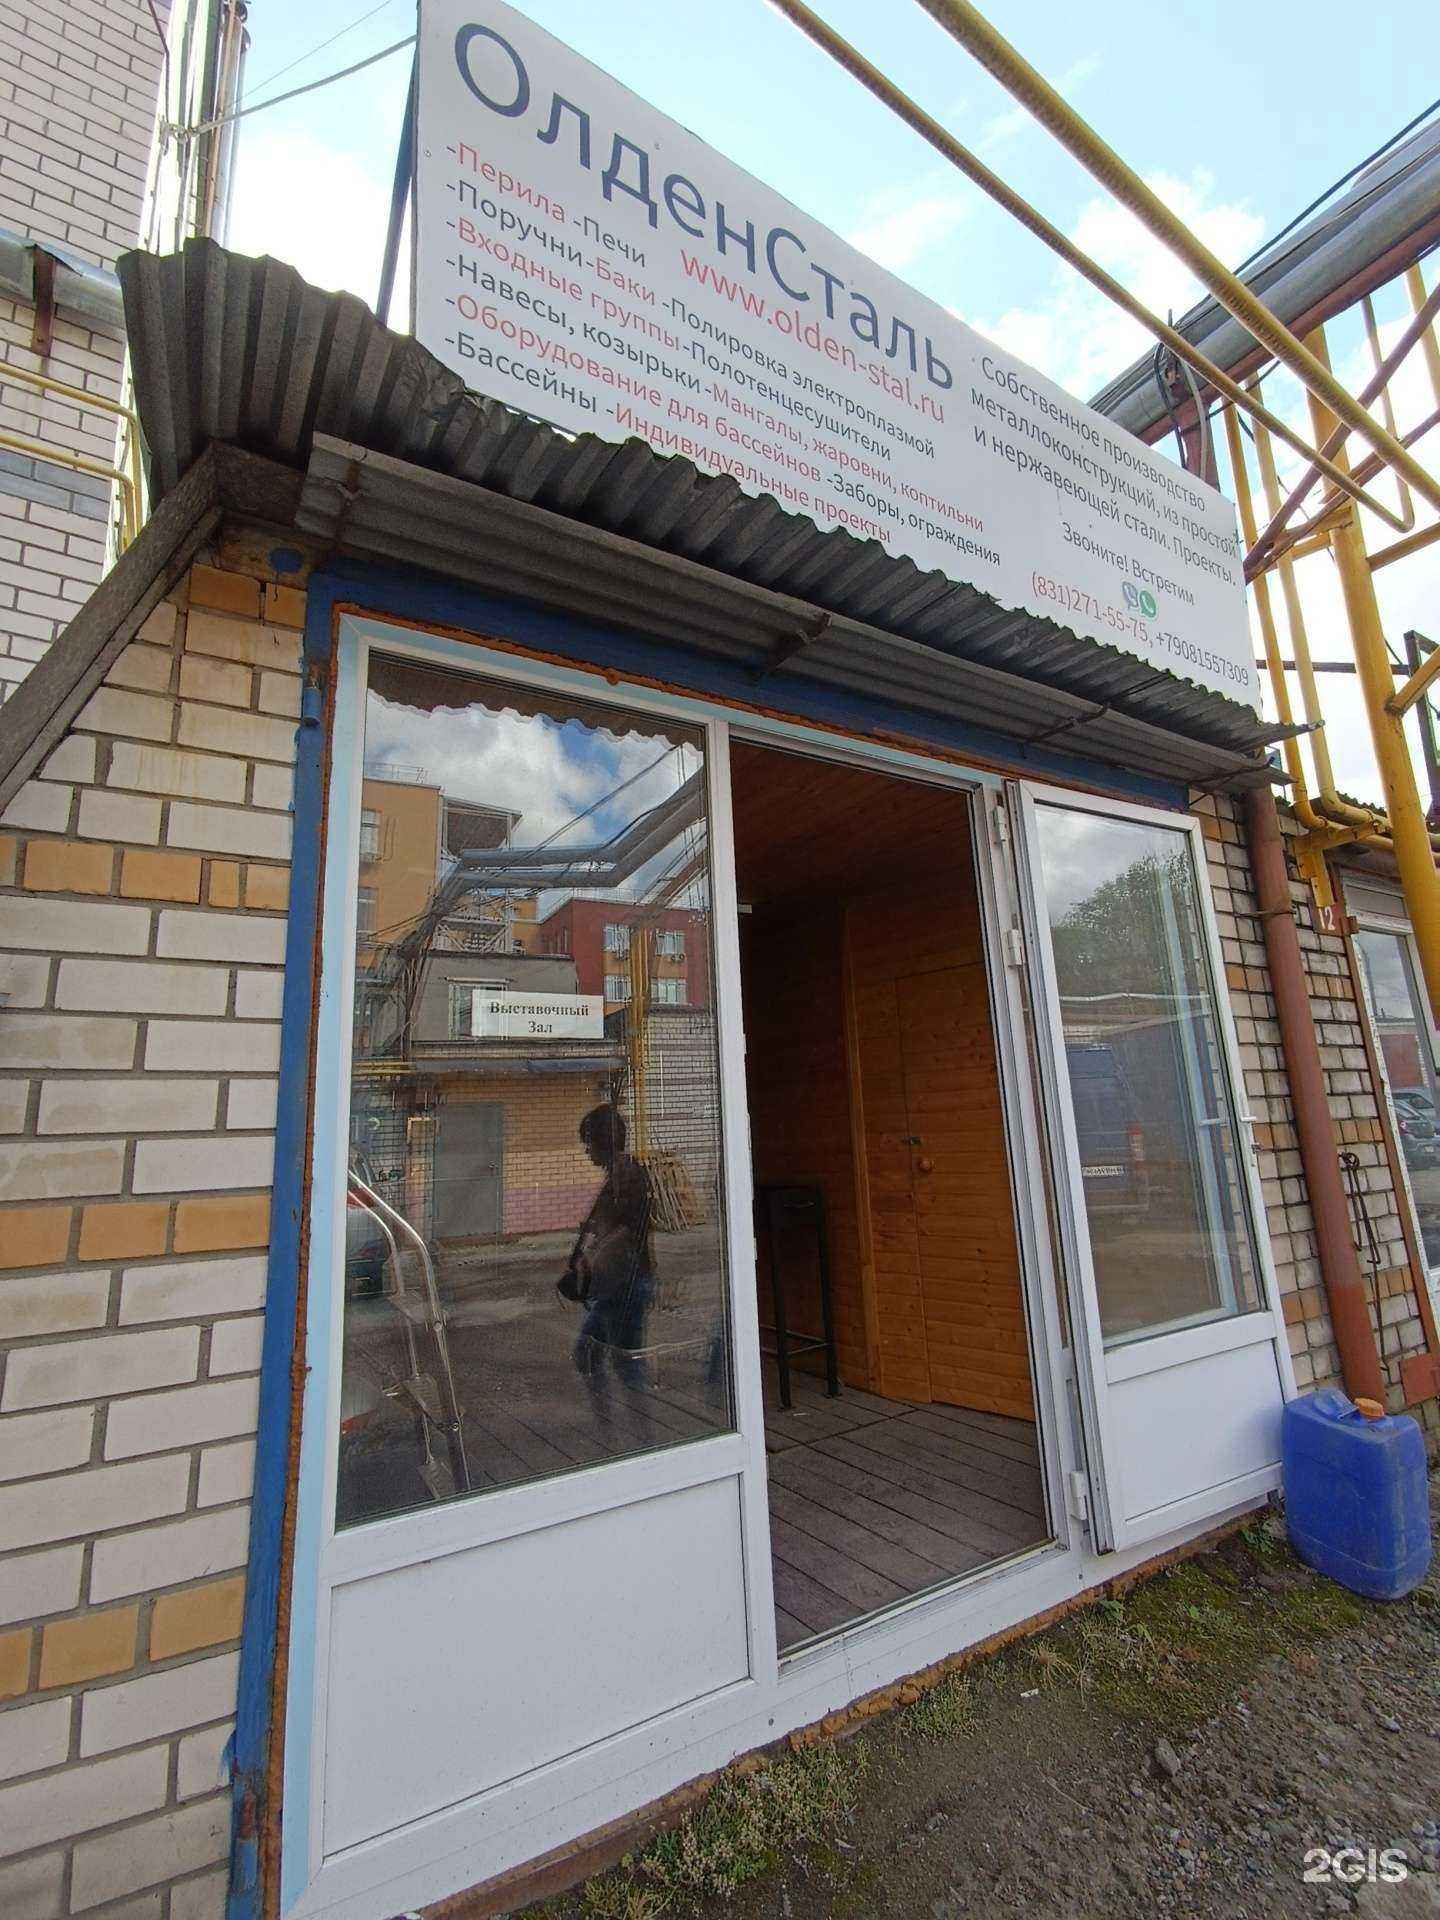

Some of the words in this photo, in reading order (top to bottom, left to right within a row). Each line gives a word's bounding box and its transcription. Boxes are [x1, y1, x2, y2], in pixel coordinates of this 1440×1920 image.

[446, 142, 565, 224] -Перила
[573, 216, 645, 267] -Печи
[446, 217, 583, 301] -Входные
[455, 22, 952, 390] ОлденСталь
[662, 298, 787, 379] -Полировка
[792, 370, 935, 459] электроплазмой
[681, 249, 944, 423] www.olden-stal.ru
[445, 332, 596, 413] -Бассейны
[815, 497, 890, 543] проекты
[446, 294, 661, 407] -Оборудование
[667, 398, 709, 429] для
[715, 416, 821, 482] бассейнов
[908, 513, 1000, 565] ограждения
[583, 323, 700, 393] козырьки
[813, 438, 897, 494] жаровни,
[901, 483, 983, 532] коптильни
[972, 388, 1161, 518] металлоконструкций,
[1163, 502, 1179, 526] из
[1182, 516, 1237, 558] простой
[982, 356, 1100, 447] Собственное
[1104, 441, 1206, 512] производство
[993, 435, 1120, 523] нержавеющей
[1124, 512, 1170, 550] стали.
[1173, 536, 1237, 586] Проекты.
[1062, 521, 1128, 572] Звоните!
[1132, 559, 1196, 606] Встретим
[1032, 570, 1153, 648] (831)271-55-75,
[1156, 631, 1249, 686] +79081557309
[489, 1001, 589, 1017] Выставочный
[528, 1021, 553, 1033] Зал
